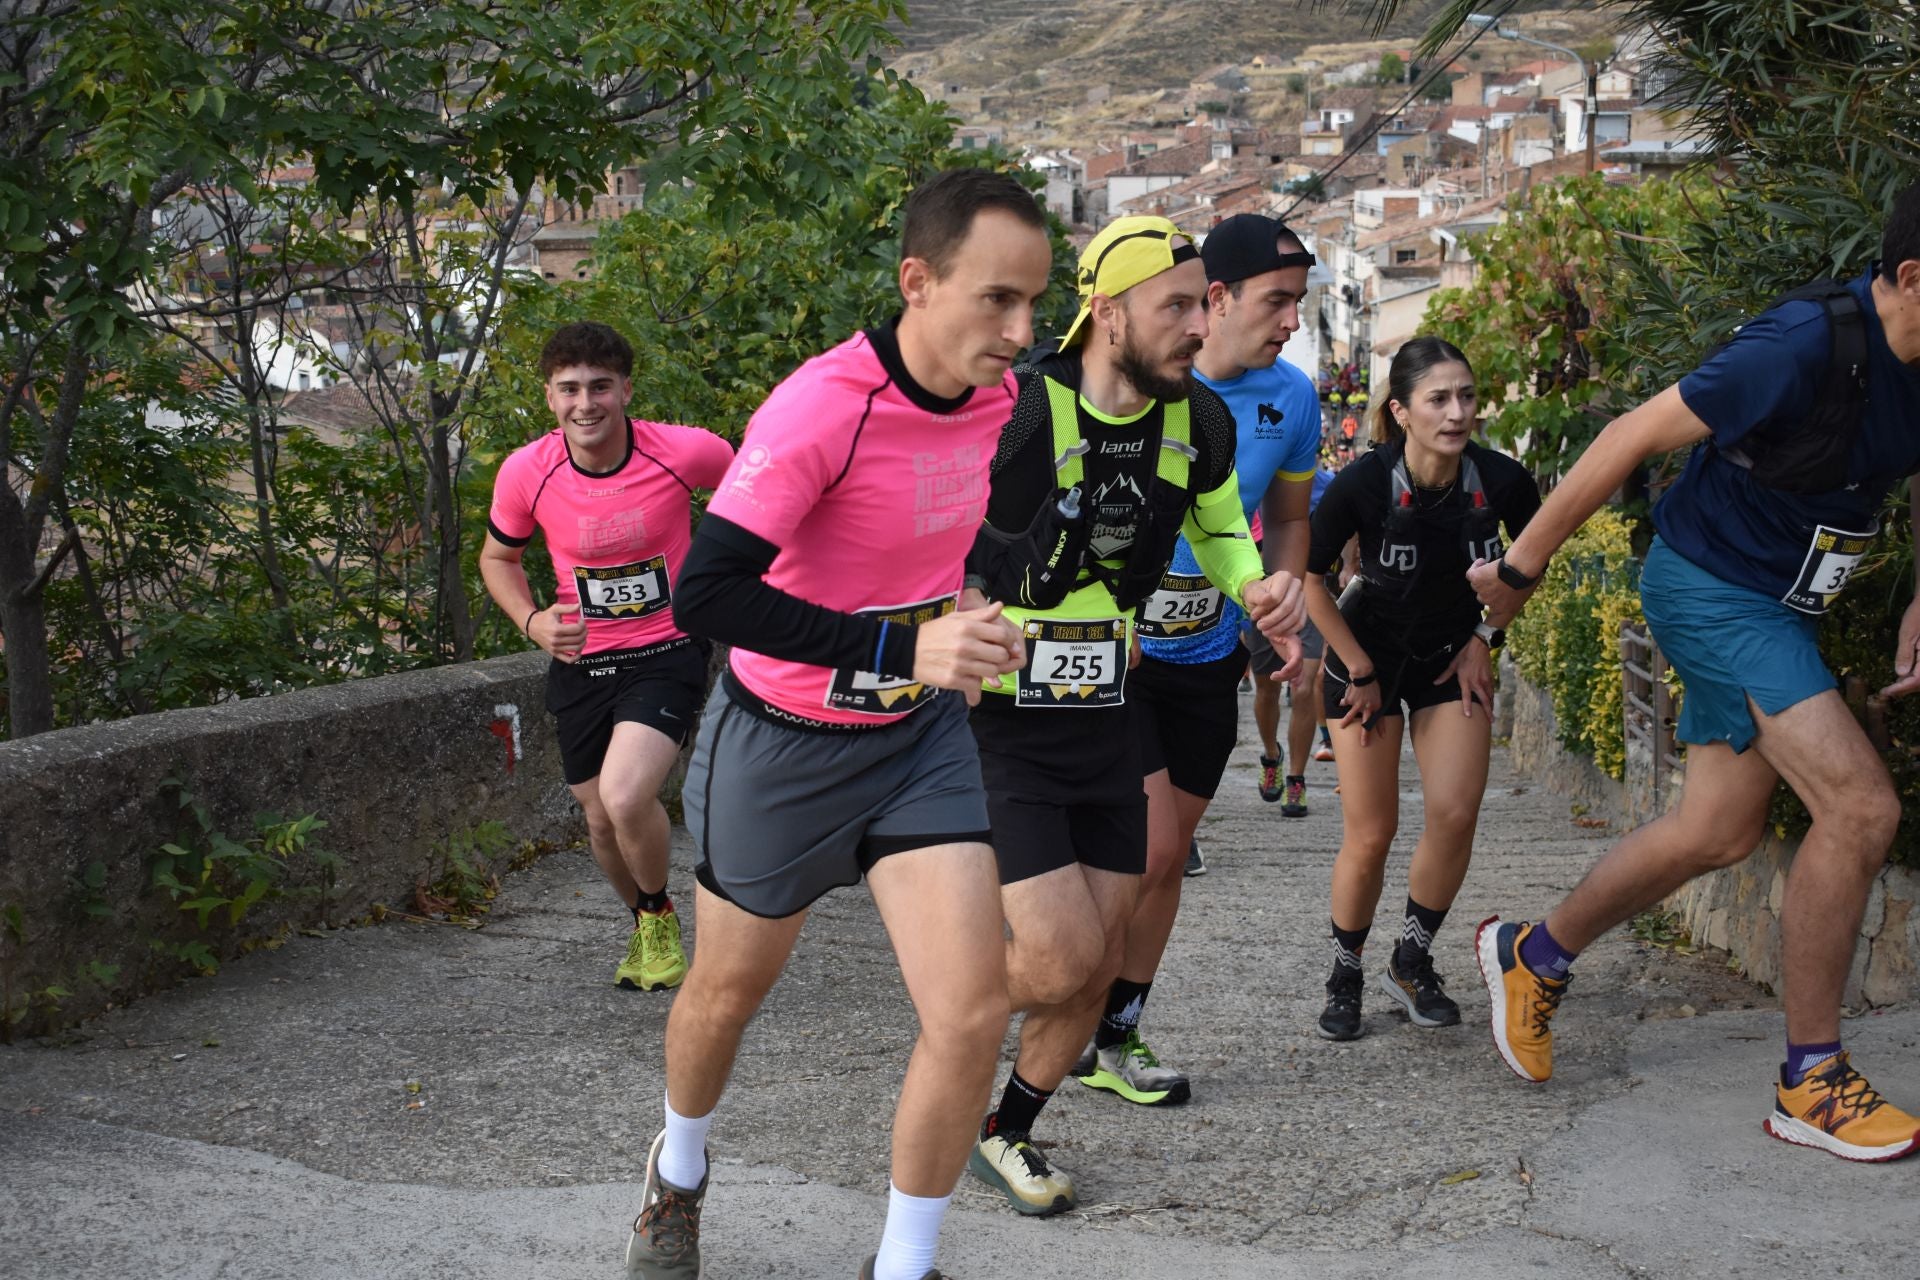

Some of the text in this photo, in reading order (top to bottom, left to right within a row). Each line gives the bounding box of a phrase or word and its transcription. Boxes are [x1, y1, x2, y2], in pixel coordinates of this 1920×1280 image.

[1100, 438, 1144, 454] land
[1047, 528, 1068, 569] AONIJIE
[602, 583, 647, 604] 253
[1162, 598, 1209, 620] 248
[1053, 626, 1084, 640] TRAIL
[1069, 644, 1094, 652] IMANOL
[1049, 654, 1103, 681] 255
